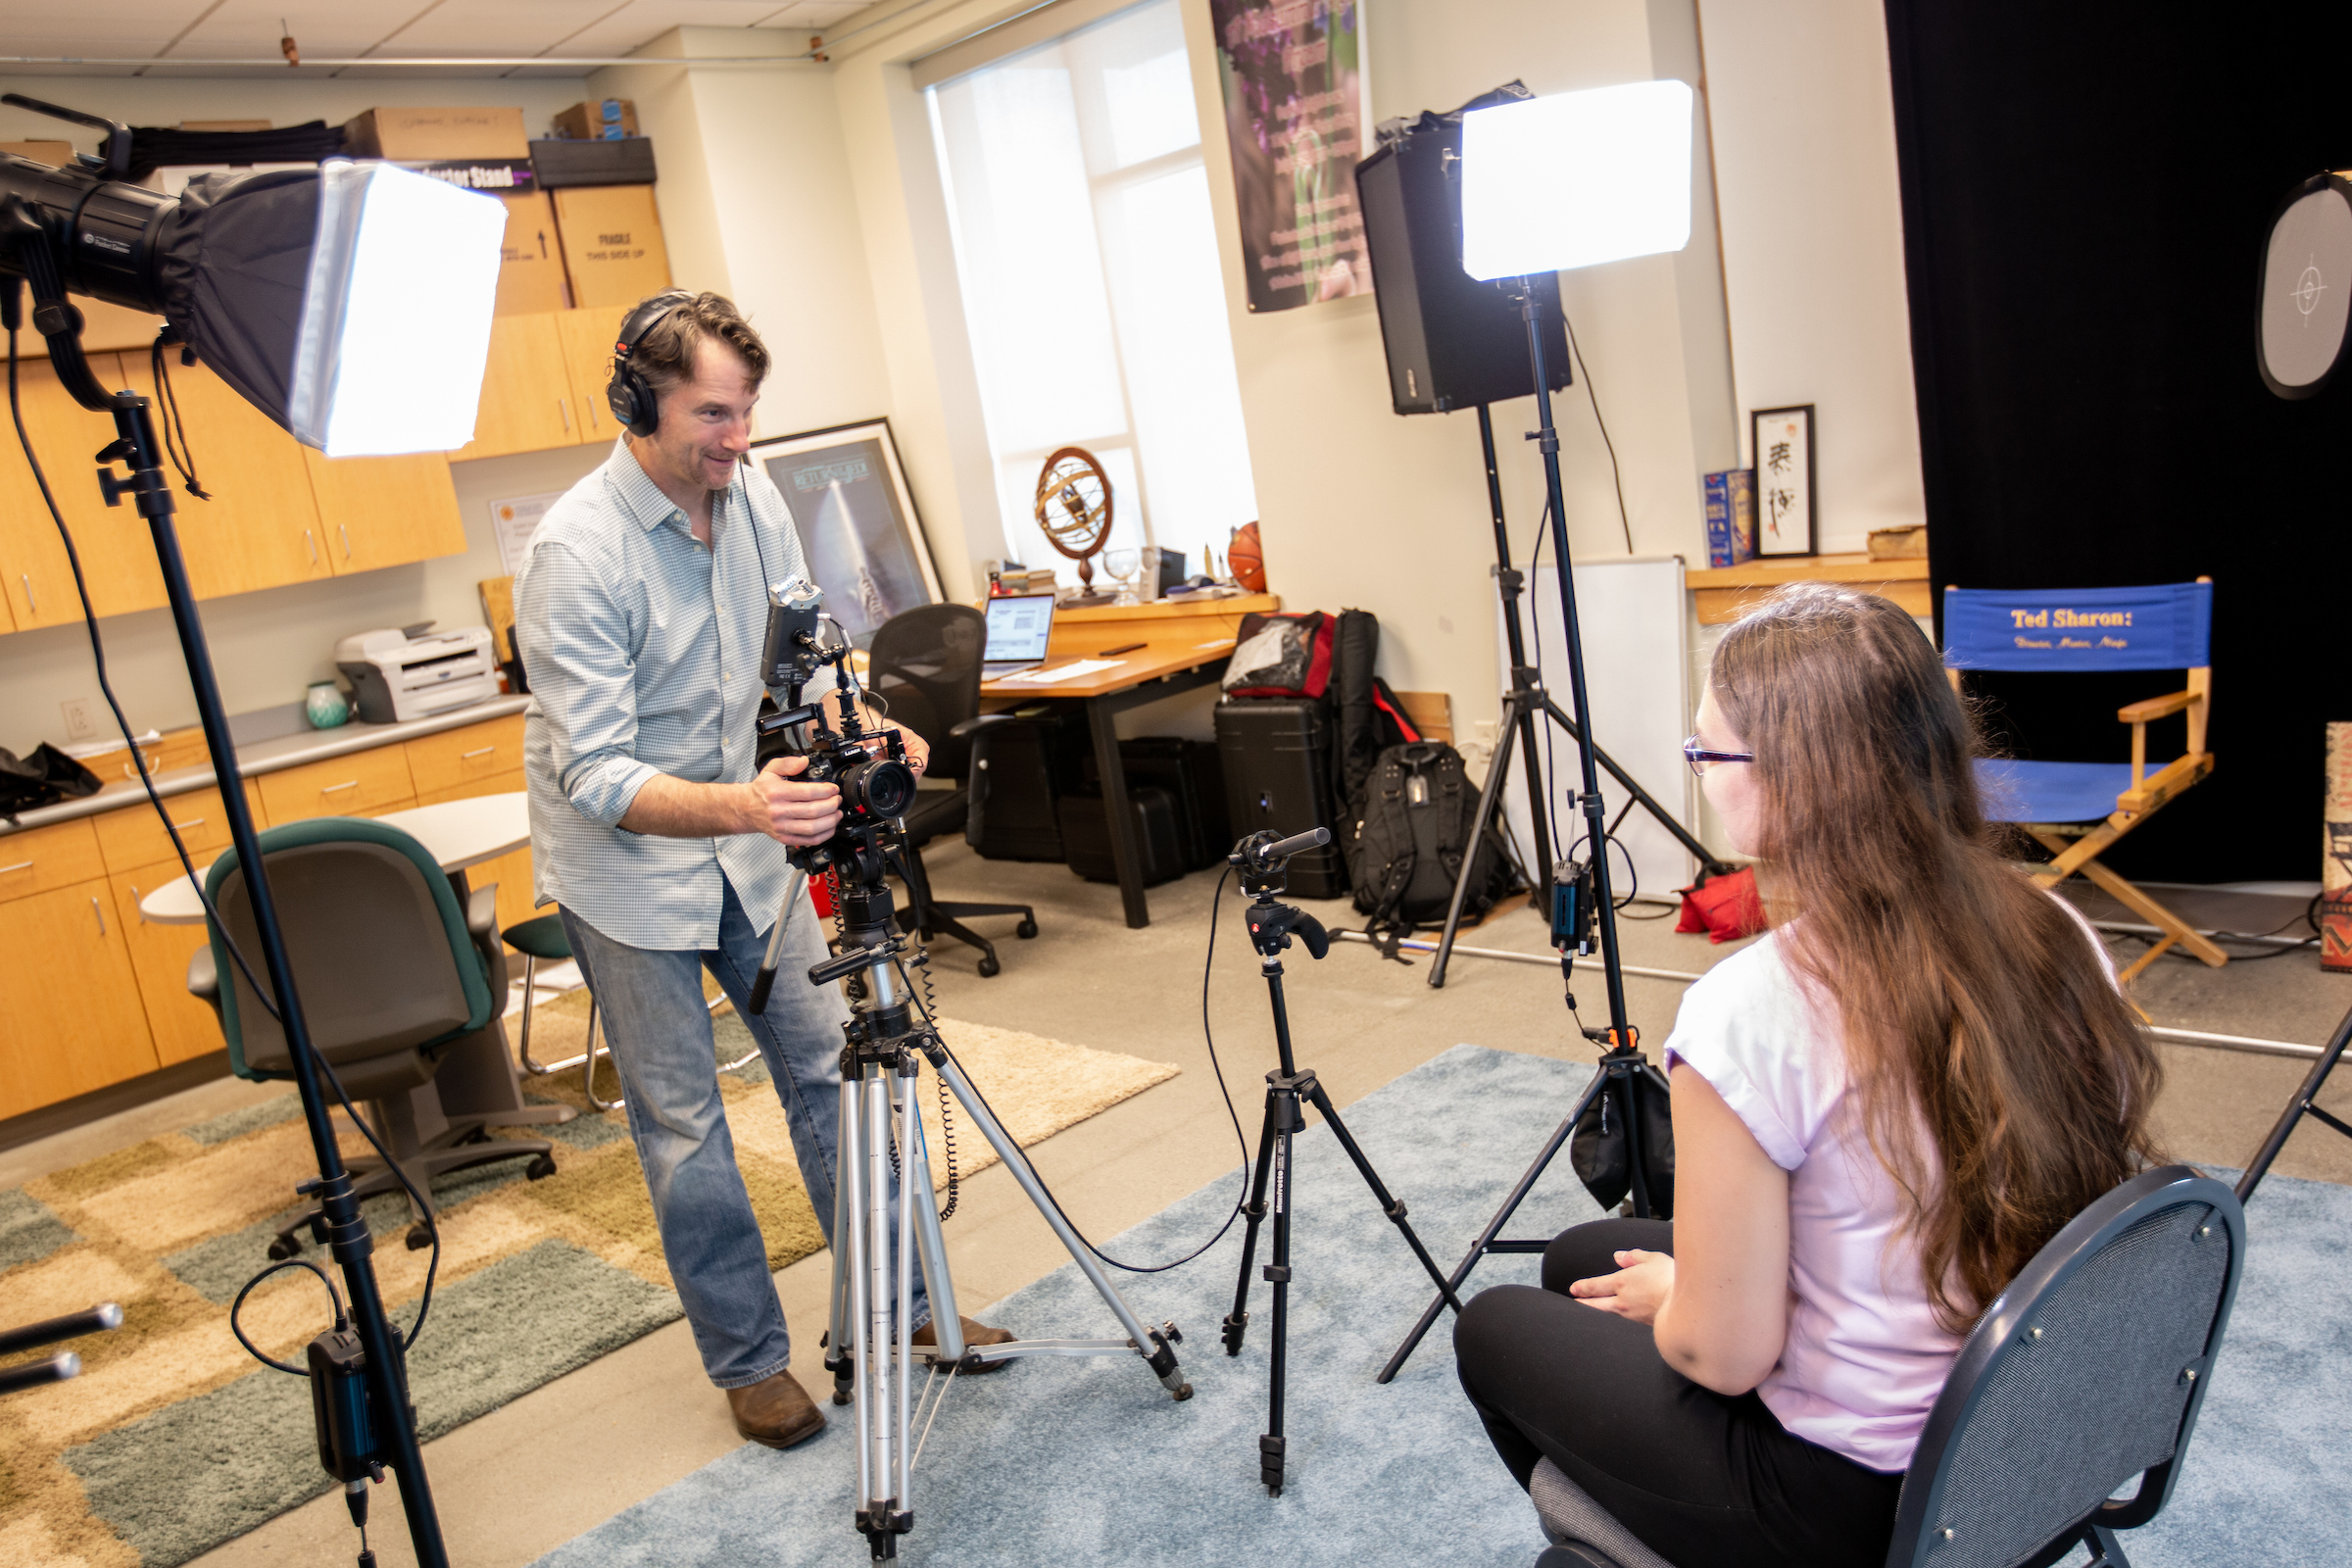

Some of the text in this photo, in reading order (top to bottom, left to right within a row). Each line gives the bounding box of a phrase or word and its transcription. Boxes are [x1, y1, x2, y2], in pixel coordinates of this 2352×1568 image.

[469, 165, 514, 188] Stand
[2010, 608, 2133, 628] Ted Sharon:
[844, 748, 861, 757] LUMIX
